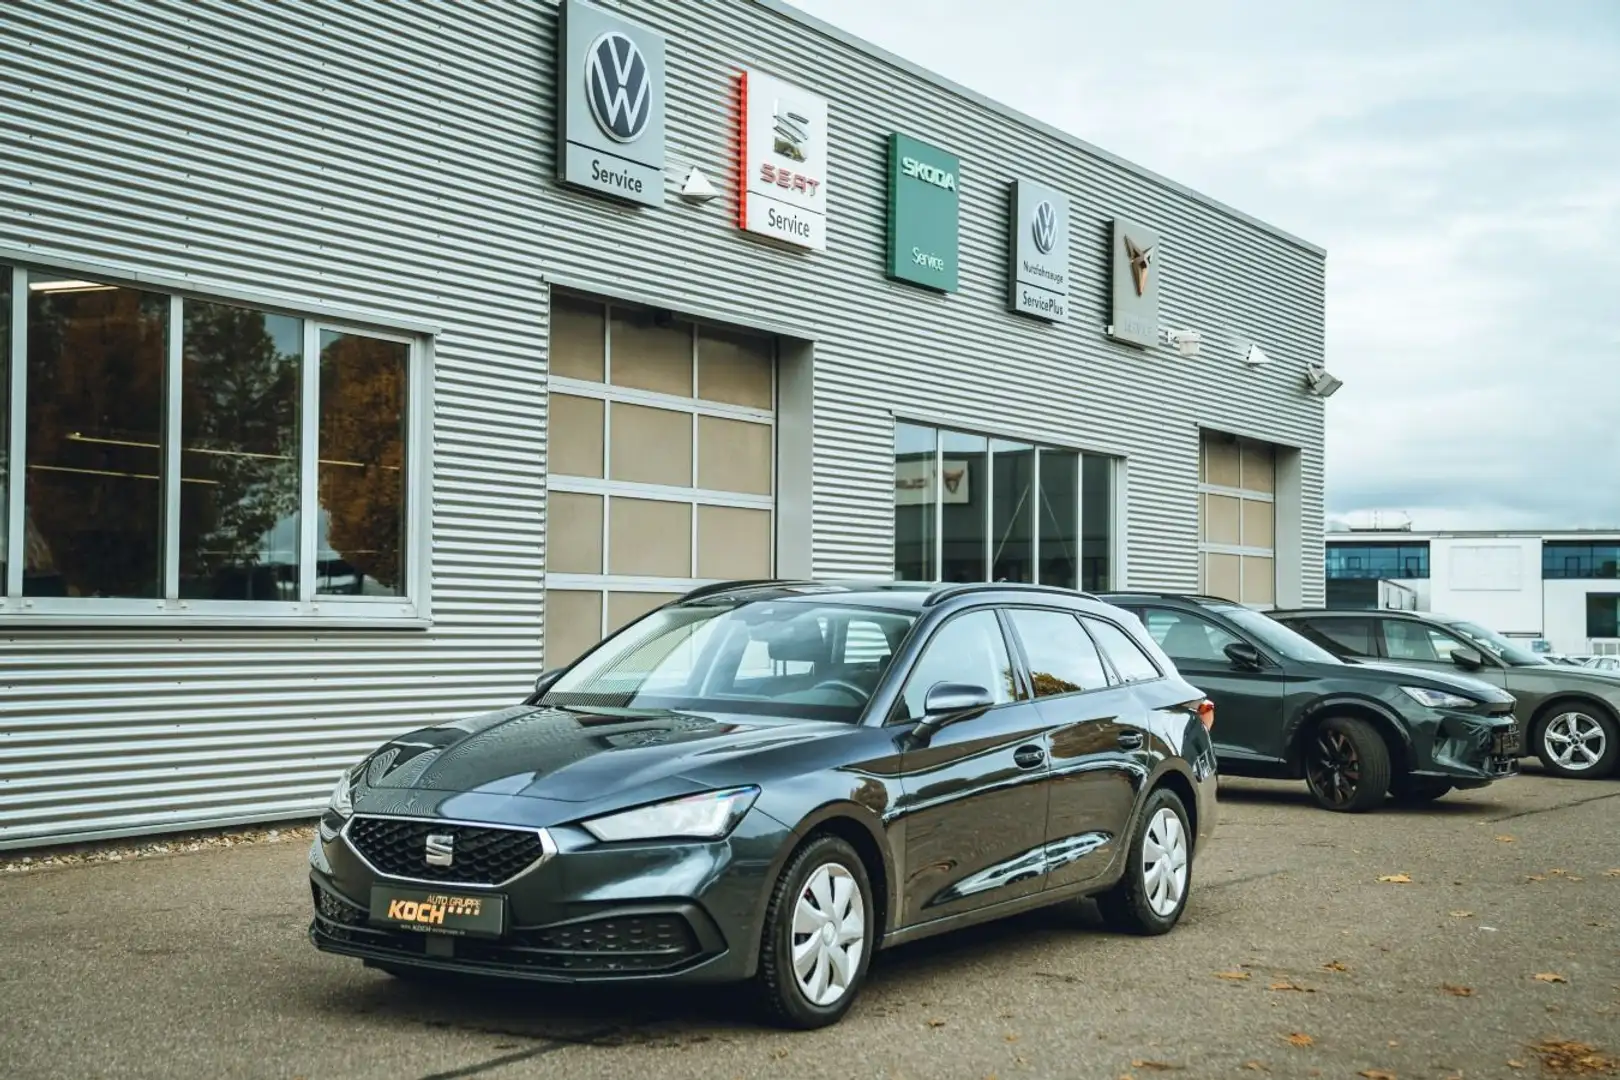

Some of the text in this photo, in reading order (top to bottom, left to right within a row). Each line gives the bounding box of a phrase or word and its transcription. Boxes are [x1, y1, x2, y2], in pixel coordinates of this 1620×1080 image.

[591, 160, 643, 194] Service
[759, 163, 821, 196] SEAT
[768, 207, 811, 239] Service
[911, 245, 945, 271] Service
[1023, 260, 1065, 285] Nutzfahrzeuge
[1022, 290, 1064, 316] ServicePlus
[387, 899, 446, 924] KOCH
[427, 893, 483, 909] AUTO GRUPPE
